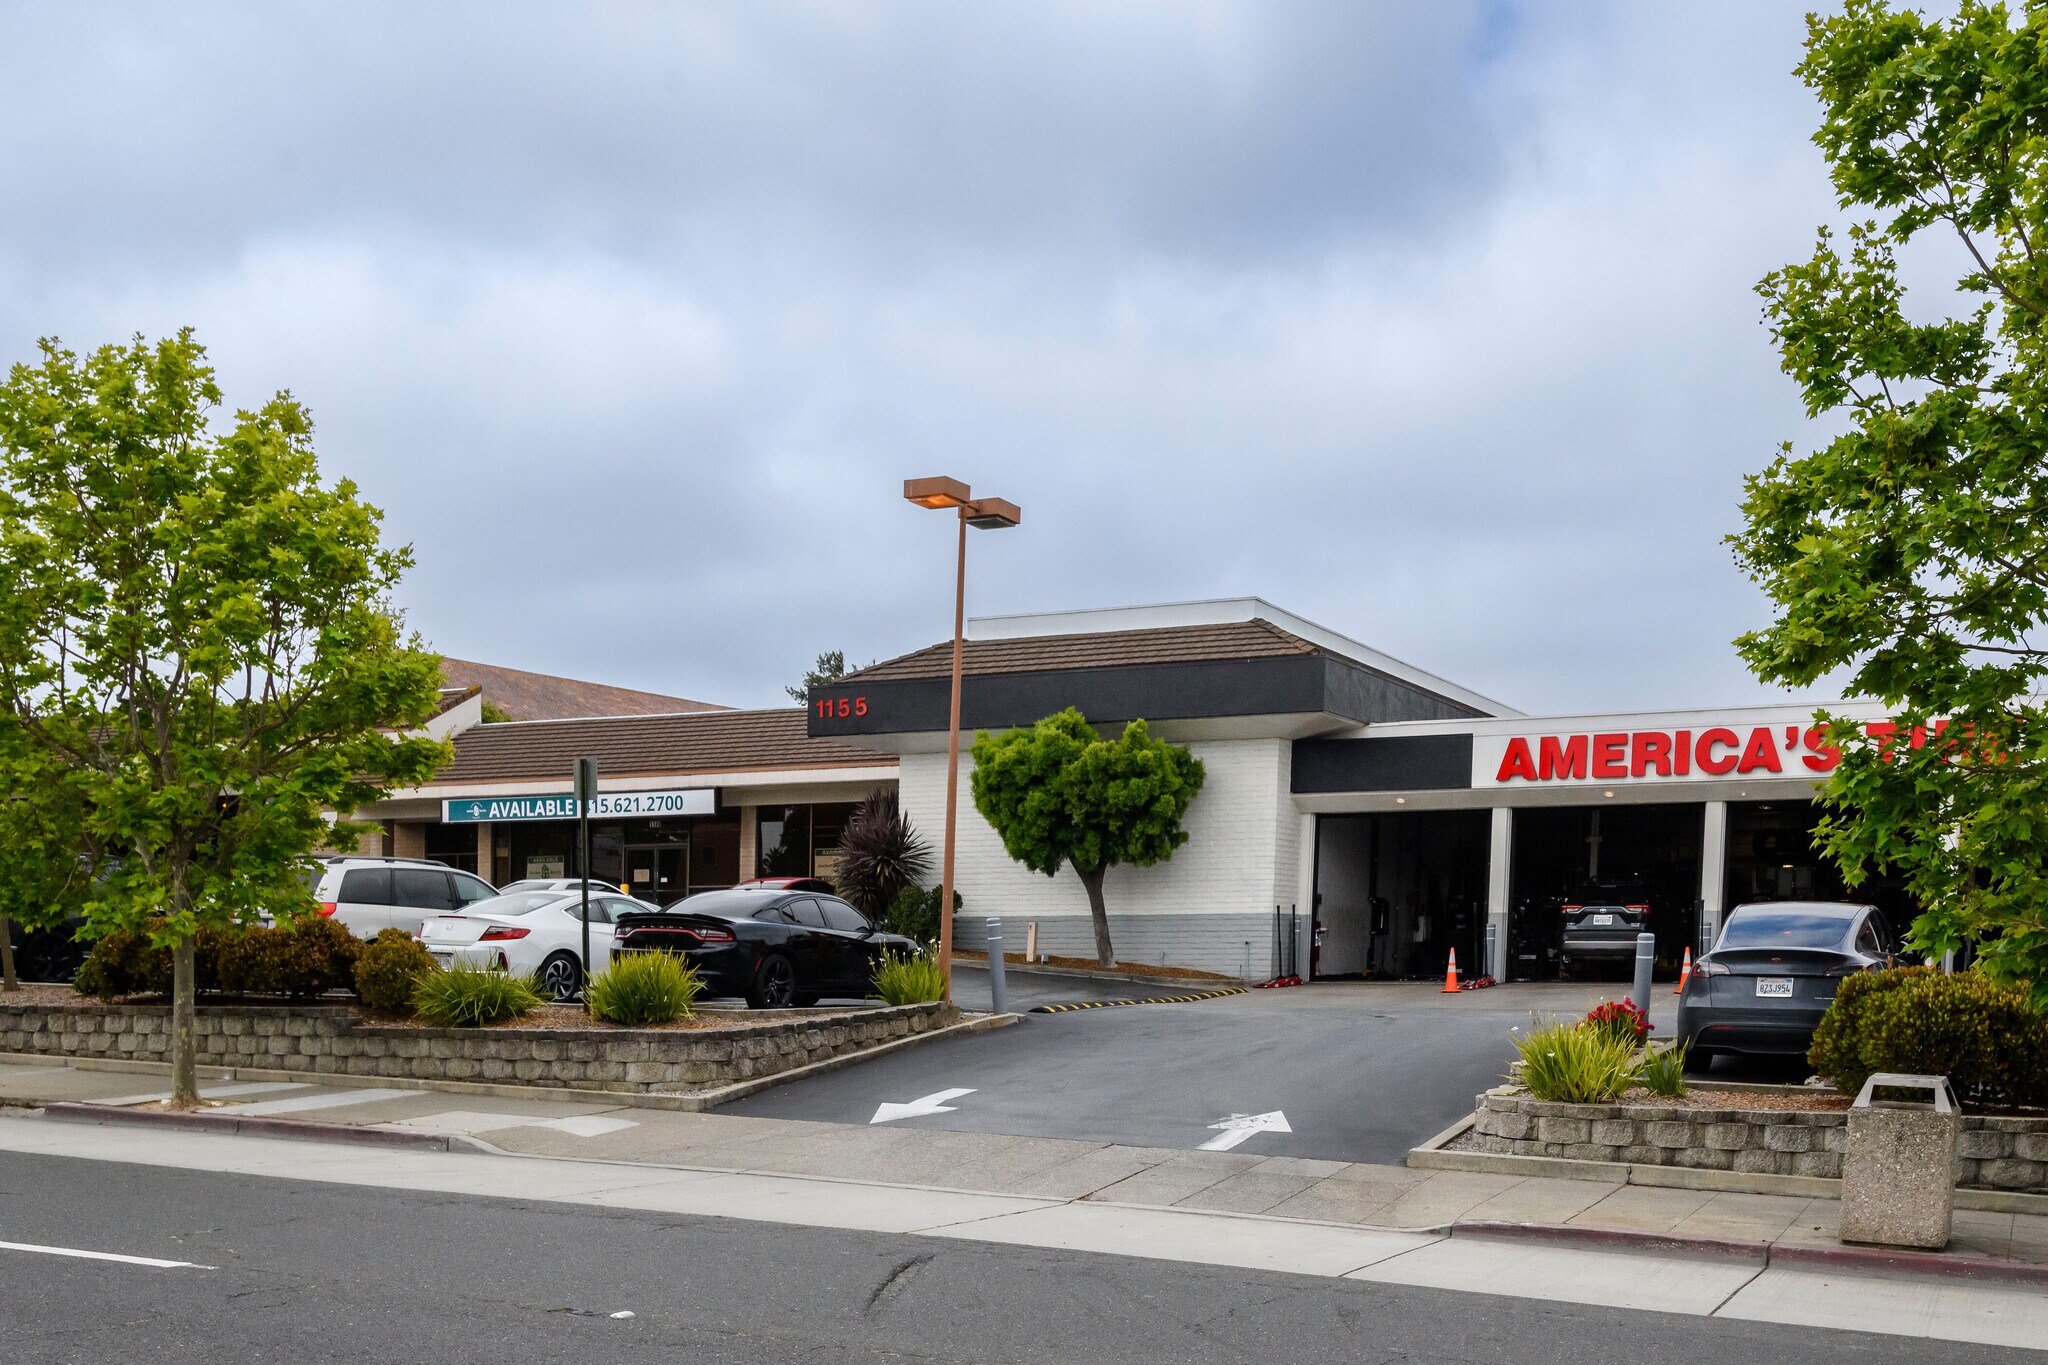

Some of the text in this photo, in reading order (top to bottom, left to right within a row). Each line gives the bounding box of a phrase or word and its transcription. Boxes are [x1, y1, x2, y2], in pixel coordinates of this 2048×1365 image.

[815, 696, 868, 718] 1155
[1496, 722, 1843, 781] AMERICA'S
[489, 800, 574, 818] AVAILABLE
[1760, 984, 1790, 993] 8ZSJ954
